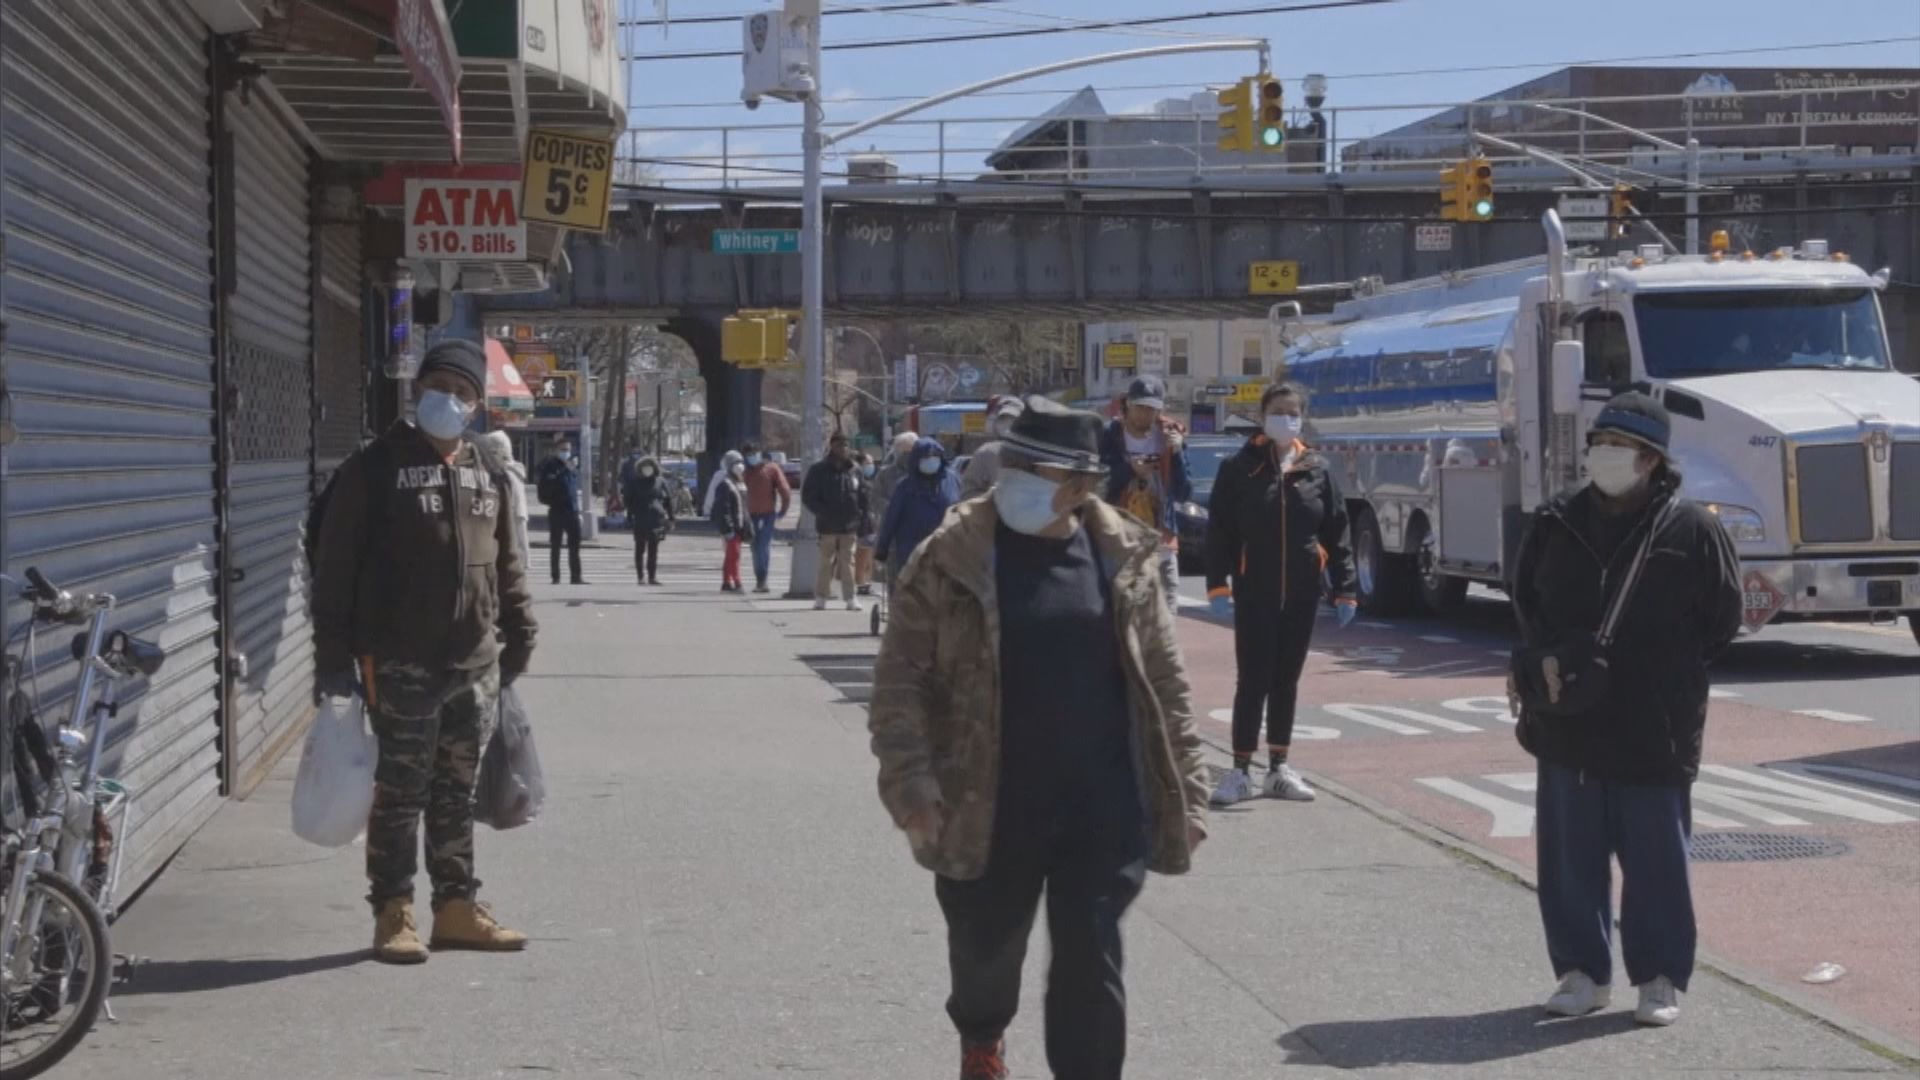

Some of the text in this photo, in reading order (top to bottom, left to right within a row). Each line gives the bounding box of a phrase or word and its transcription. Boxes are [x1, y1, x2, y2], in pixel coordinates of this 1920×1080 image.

[1765, 112, 1786, 125] NY
[1791, 111, 1851, 126] TBETAN
[533, 136, 606, 171] COPIES
[413, 188, 517, 226] ATM
[417, 231, 516, 253] $10. Bills
[719, 231, 778, 252] Whitney
[1748, 435, 1777, 448] 4147
[1744, 593, 1771, 608] 993
